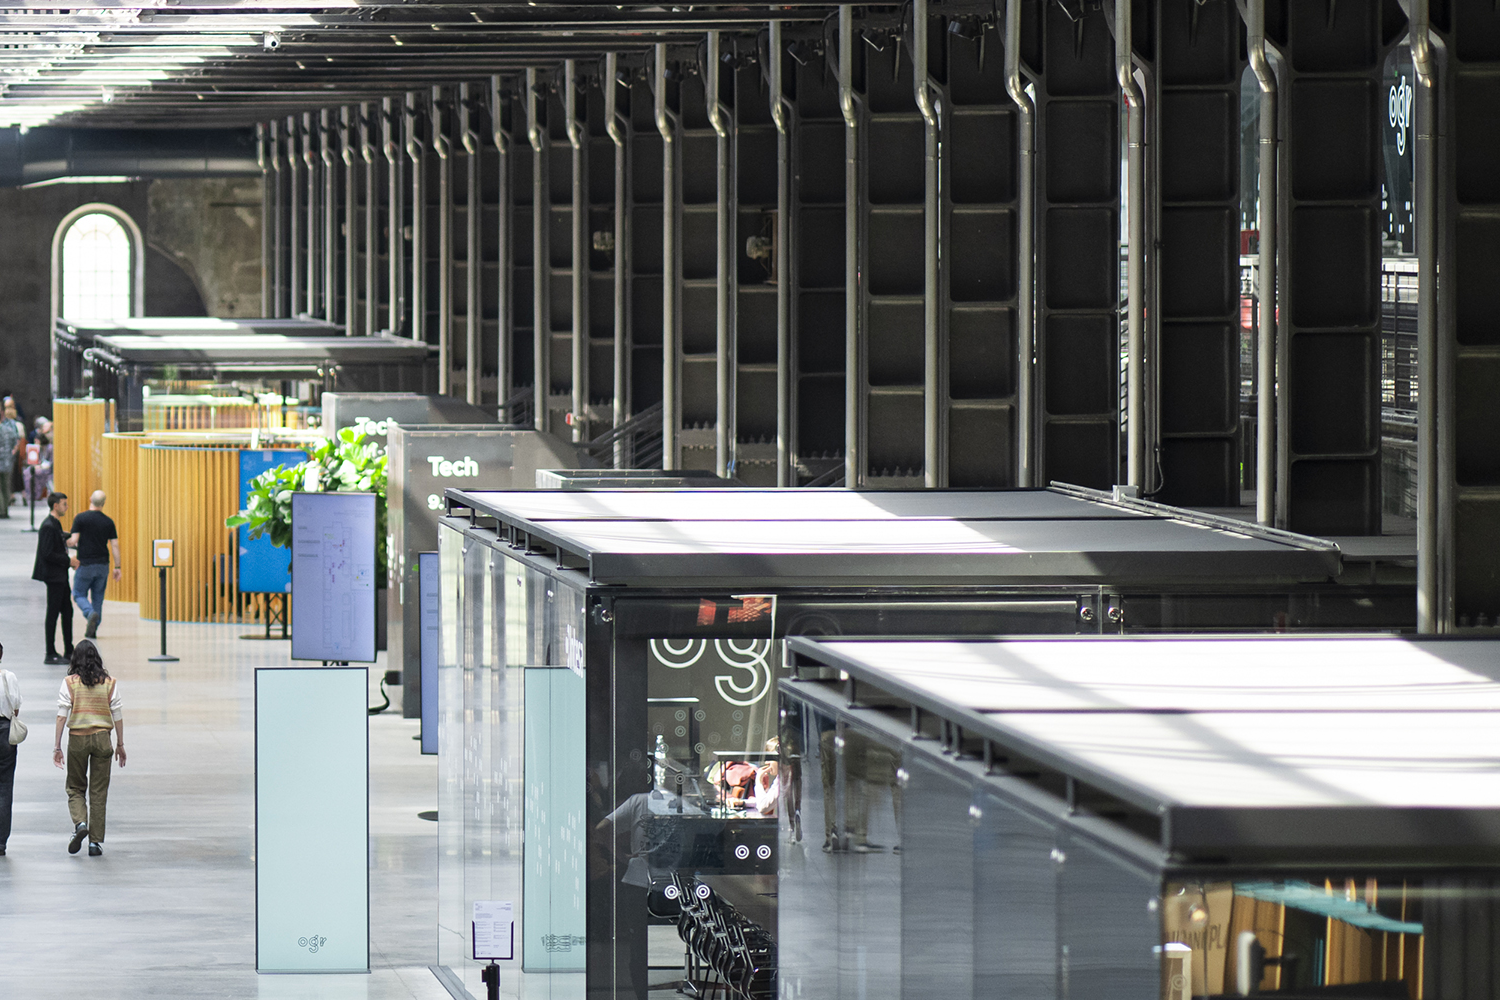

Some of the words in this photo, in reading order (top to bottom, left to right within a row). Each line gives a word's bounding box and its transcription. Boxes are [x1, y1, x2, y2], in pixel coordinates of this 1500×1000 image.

[1388, 75, 1413, 156] ogr
[427, 456, 479, 477] Tech
[297, 934, 328, 954] ogr
